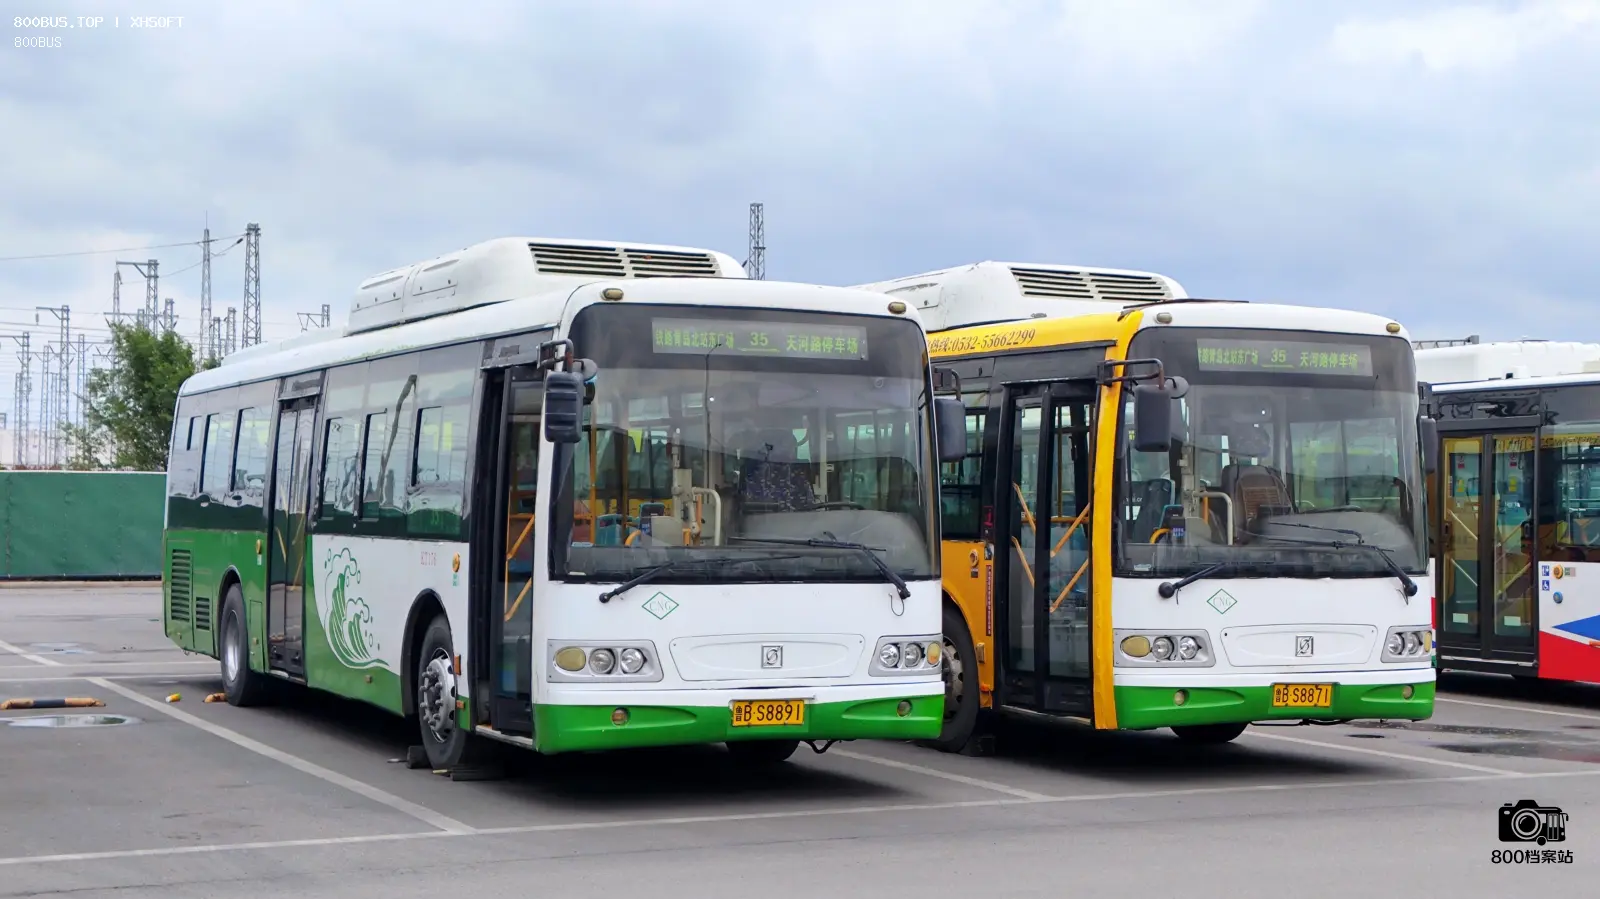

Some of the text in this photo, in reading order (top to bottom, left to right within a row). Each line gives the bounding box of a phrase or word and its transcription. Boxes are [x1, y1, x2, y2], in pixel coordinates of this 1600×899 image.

[750, 332, 769, 346] 35
[786, 334, 858, 354] 天河路停车场
[928, 328, 1036, 353] 热线:0532-55662299
[1271, 348, 1287, 363] 35
[1300, 351, 1358, 370] 天河路停车场
[649, 600, 672, 611] CNG
[1212, 596, 1232, 606] CNG
